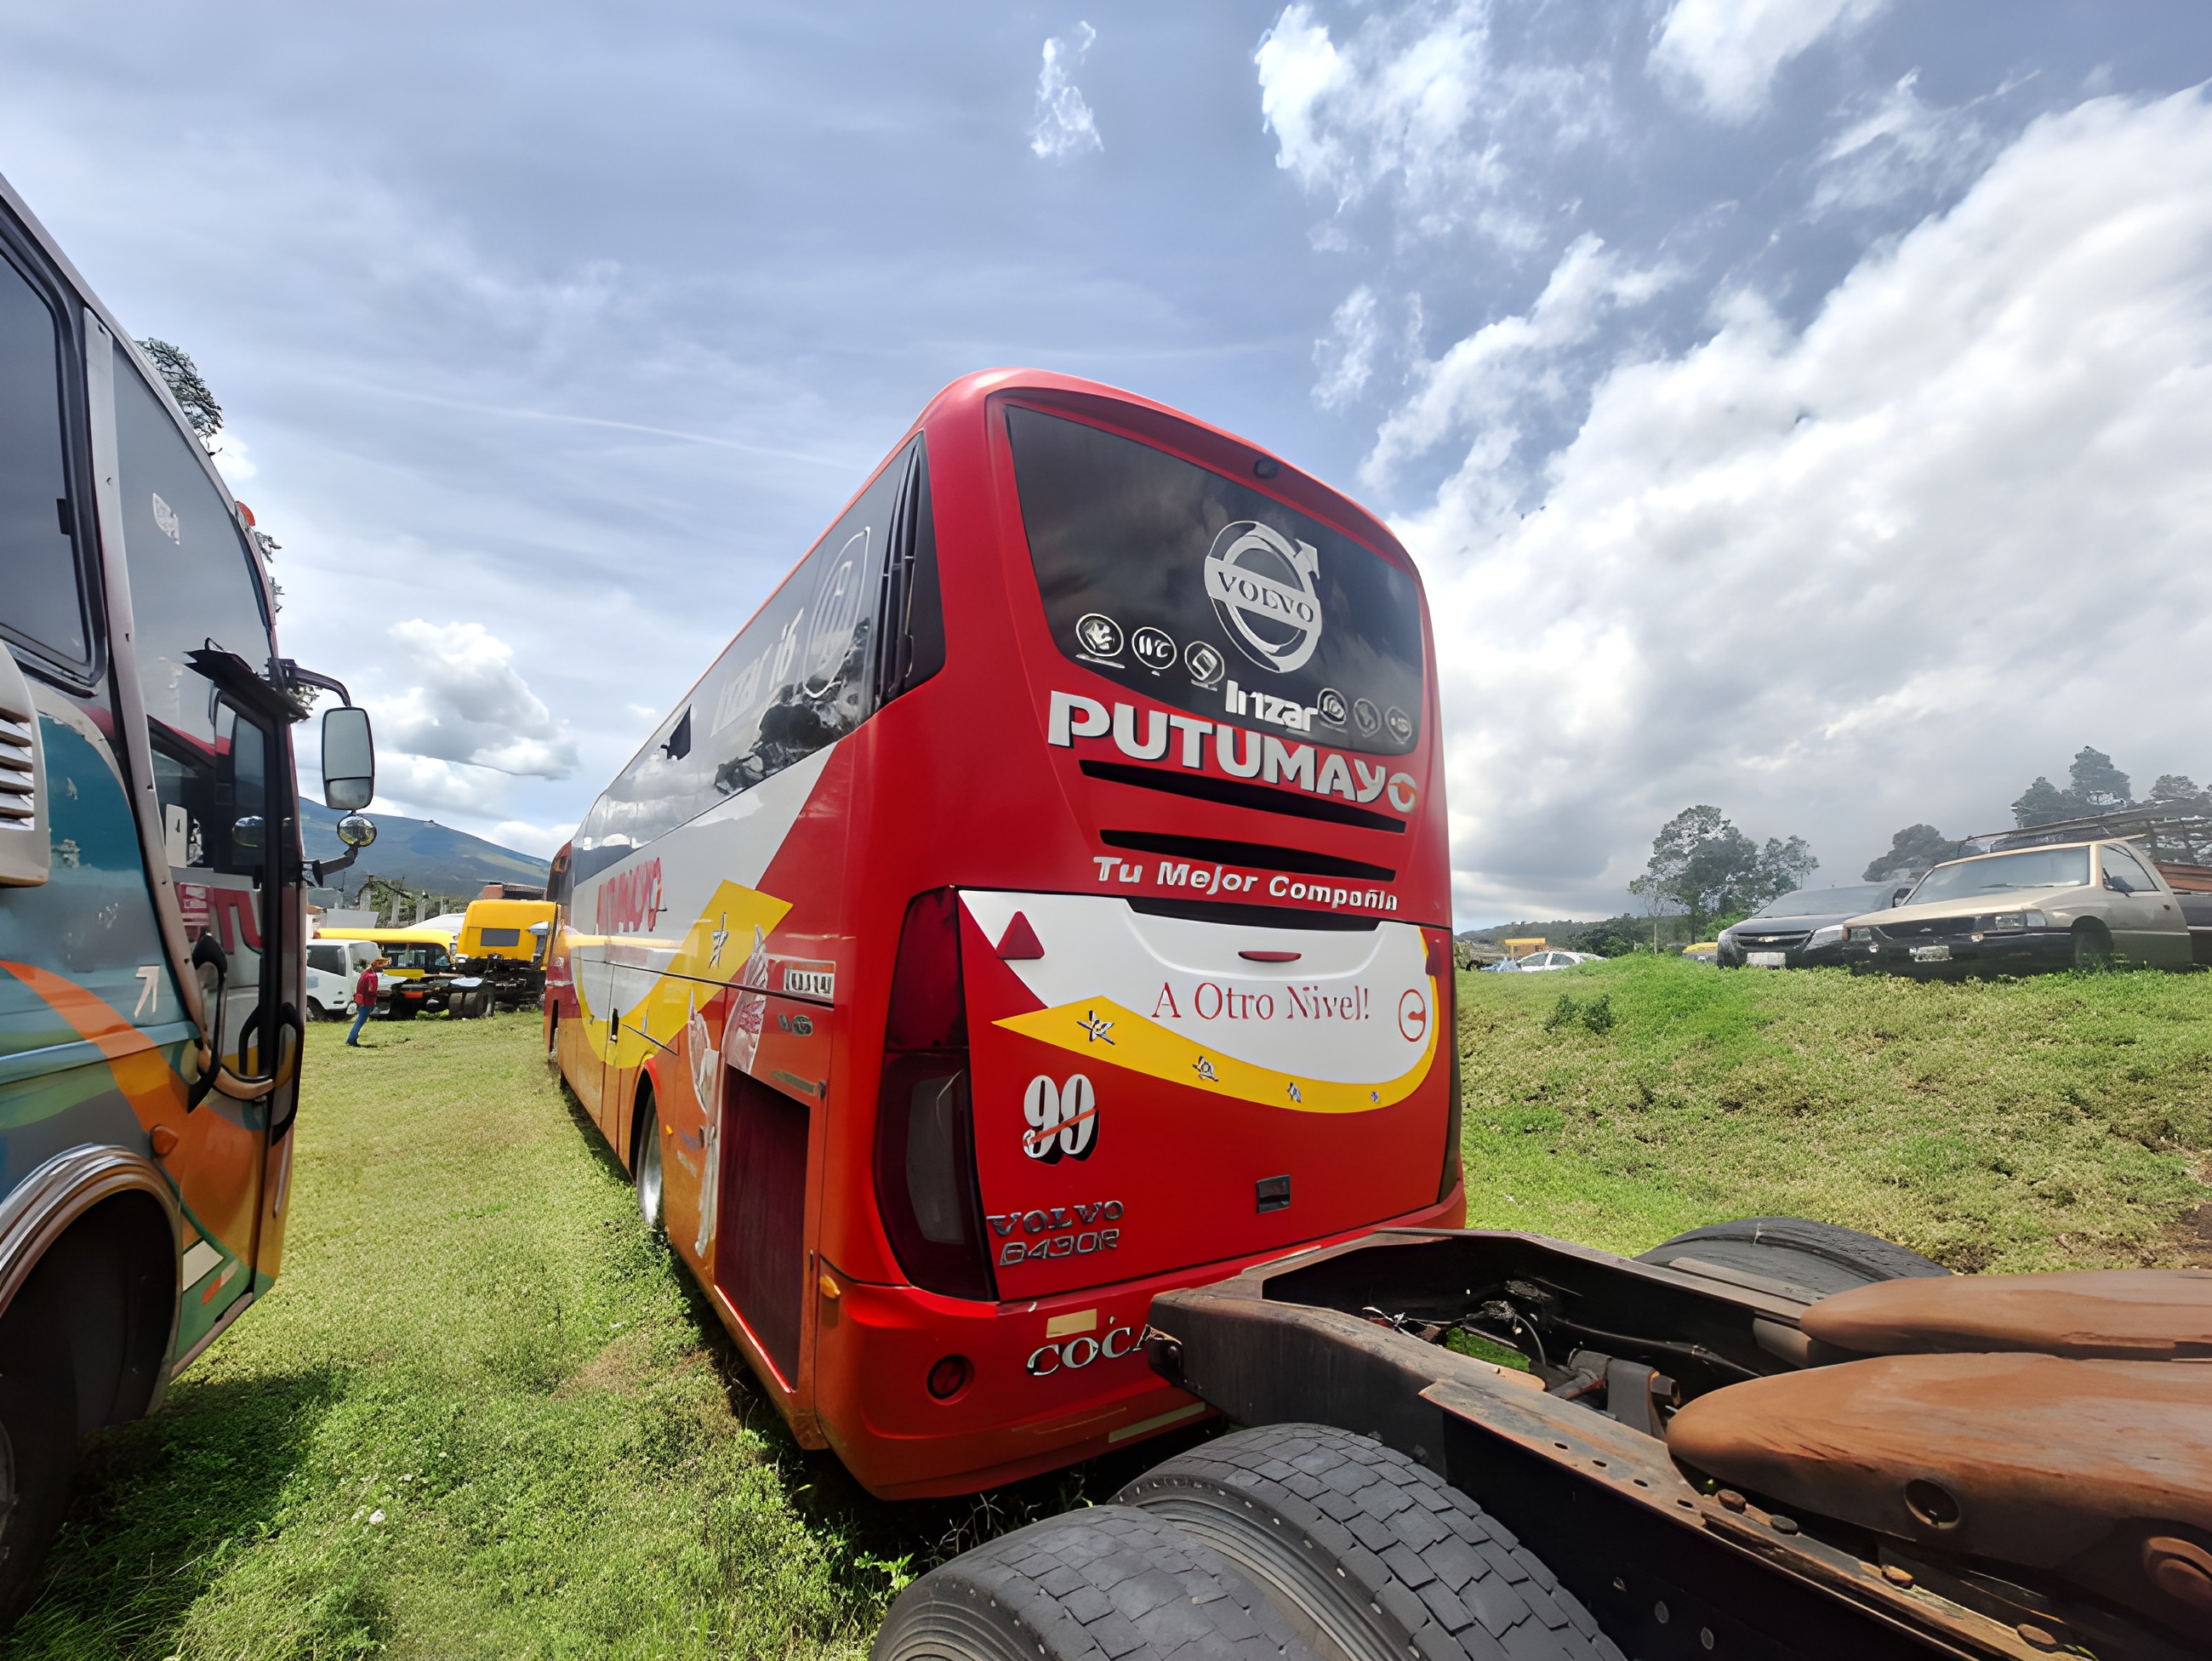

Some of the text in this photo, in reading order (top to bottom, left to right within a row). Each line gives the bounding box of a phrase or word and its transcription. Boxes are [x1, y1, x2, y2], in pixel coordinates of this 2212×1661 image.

[1217, 570, 1314, 623] VOLVO
[1092, 856, 1143, 883] Tu
[1156, 861, 1259, 895] Mejor
[1151, 982, 1369, 1020] A Otro Nivel!
[1023, 1073, 1097, 1159] 99
[986, 1200, 1124, 1236] VOLVO
